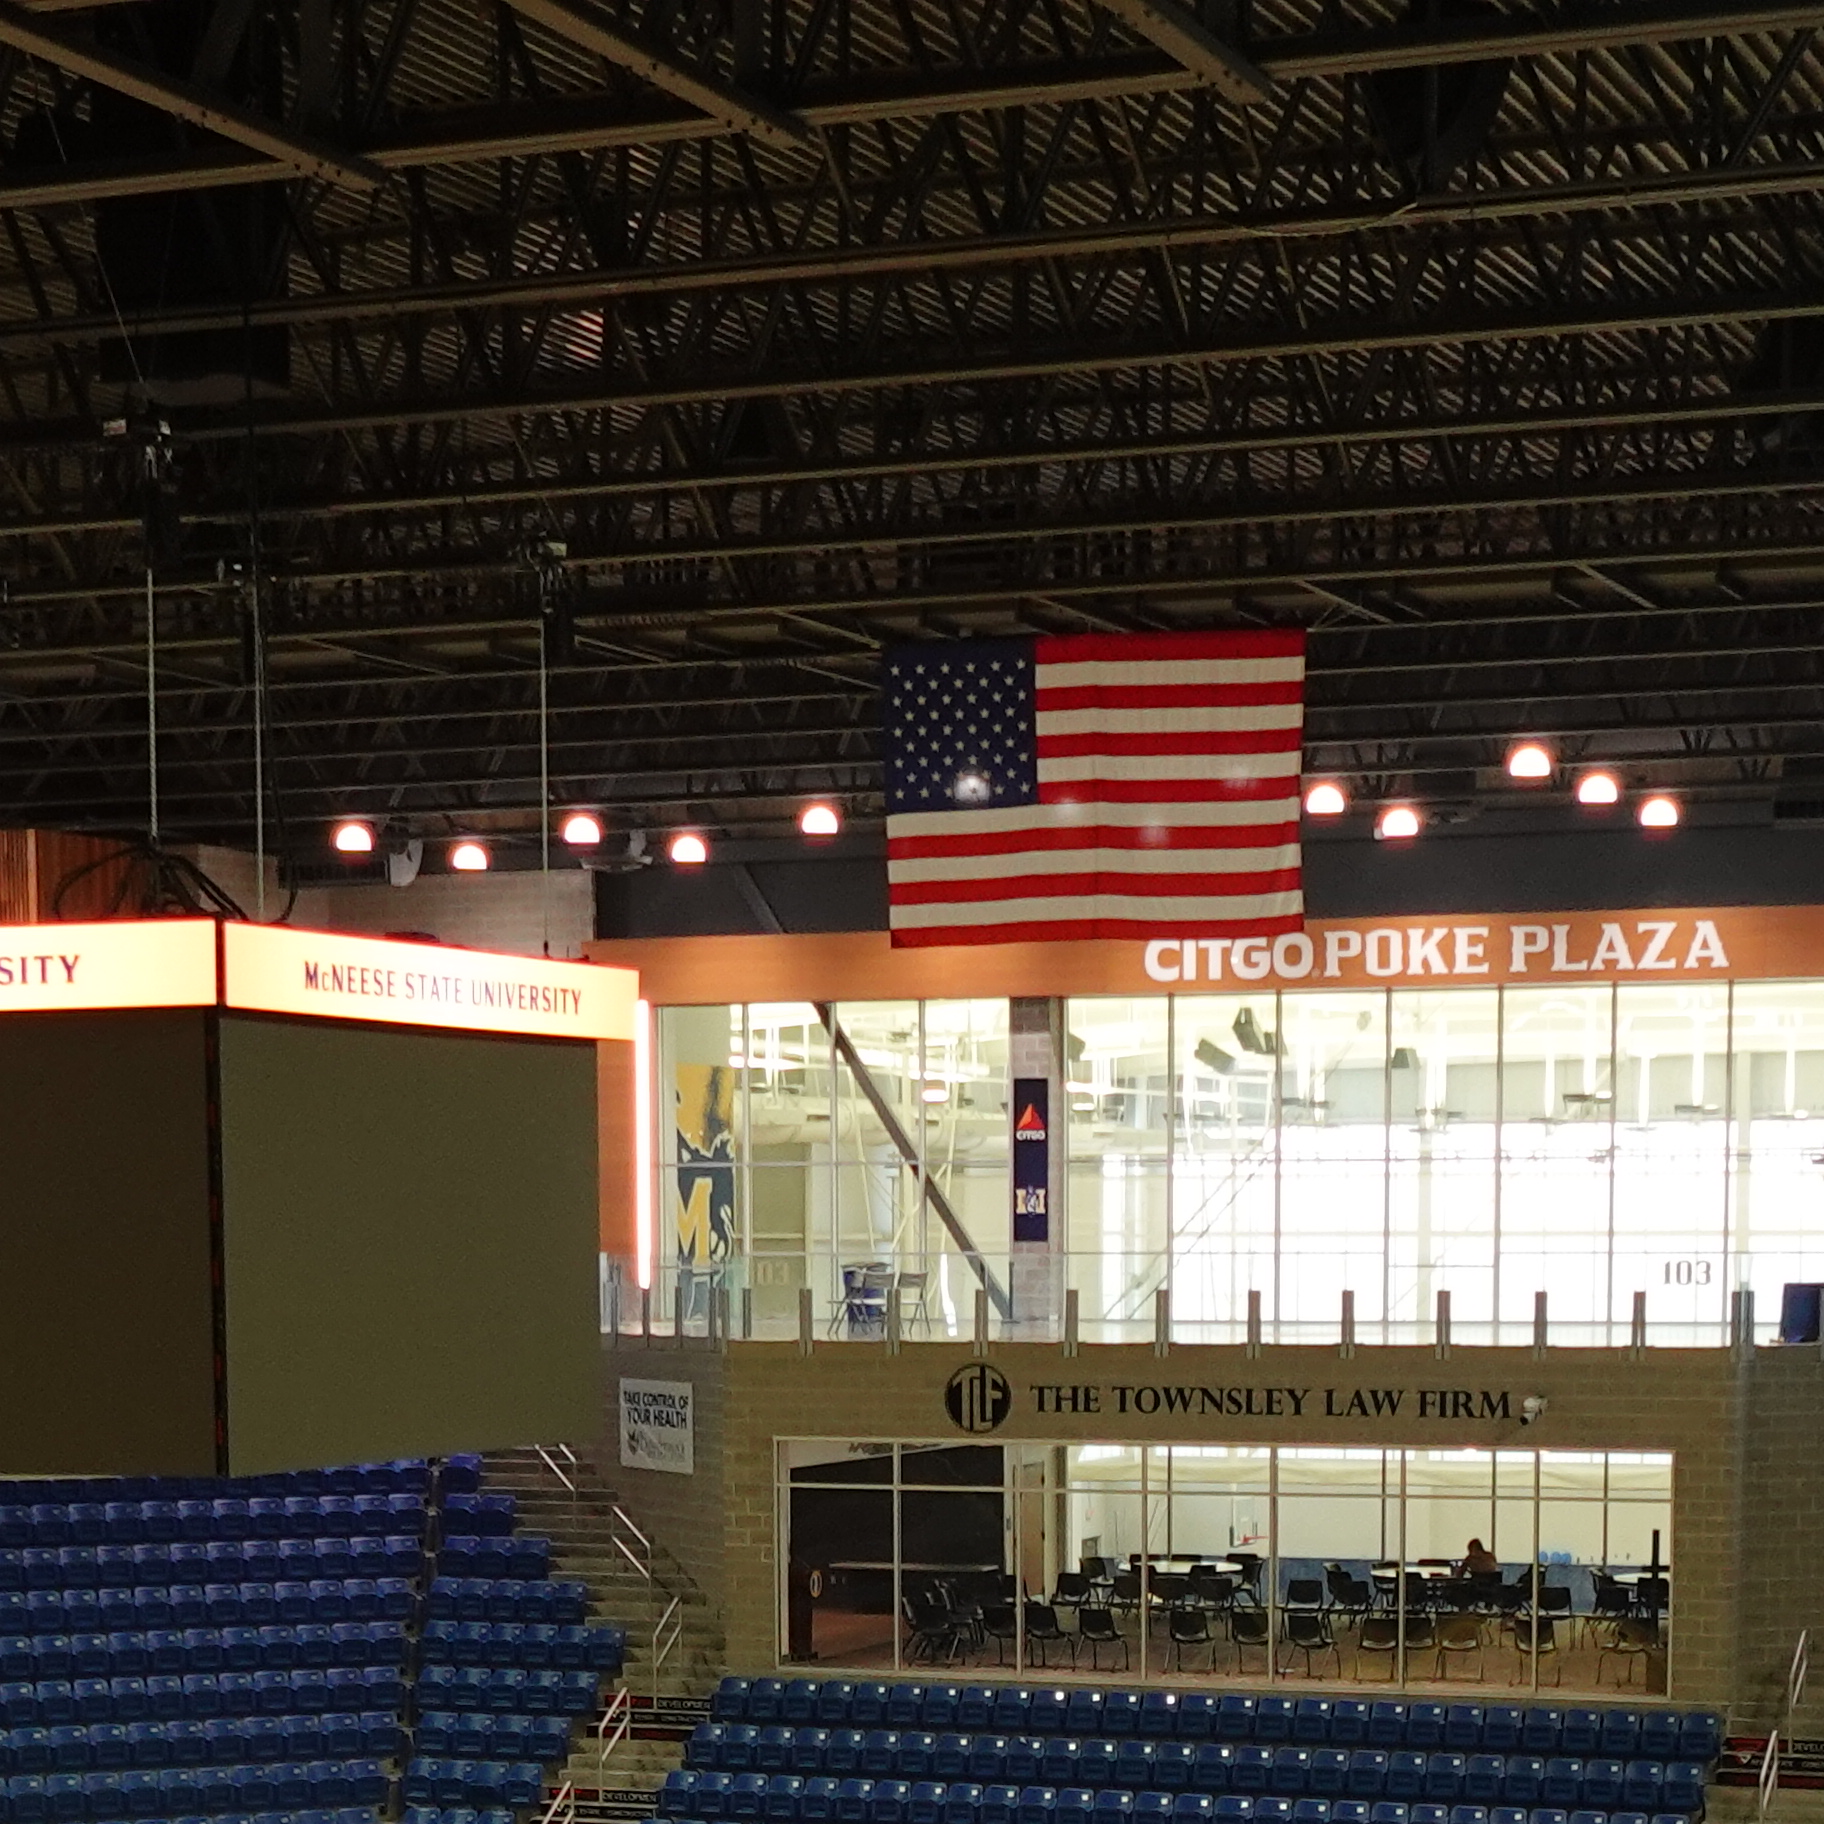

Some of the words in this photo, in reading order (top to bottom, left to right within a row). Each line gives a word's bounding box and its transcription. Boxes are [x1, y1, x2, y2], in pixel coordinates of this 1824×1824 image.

[1143, 934, 1313, 983] CITGO
[1322, 926, 1490, 979] POKE
[1508, 920, 1730, 974] PLAZA
[304, 961, 397, 998] McNEESE
[404, 972, 464, 1004] STATE
[471, 979, 583, 1016] UNIVERSITY
[1663, 1260, 1712, 1286] 103
[1029, 1384, 1102, 1414] THE
[1111, 1385, 1310, 1417] TOWNSLEY
[1324, 1388, 1407, 1418] LAW
[1416, 1390, 1513, 1420] FIRM
